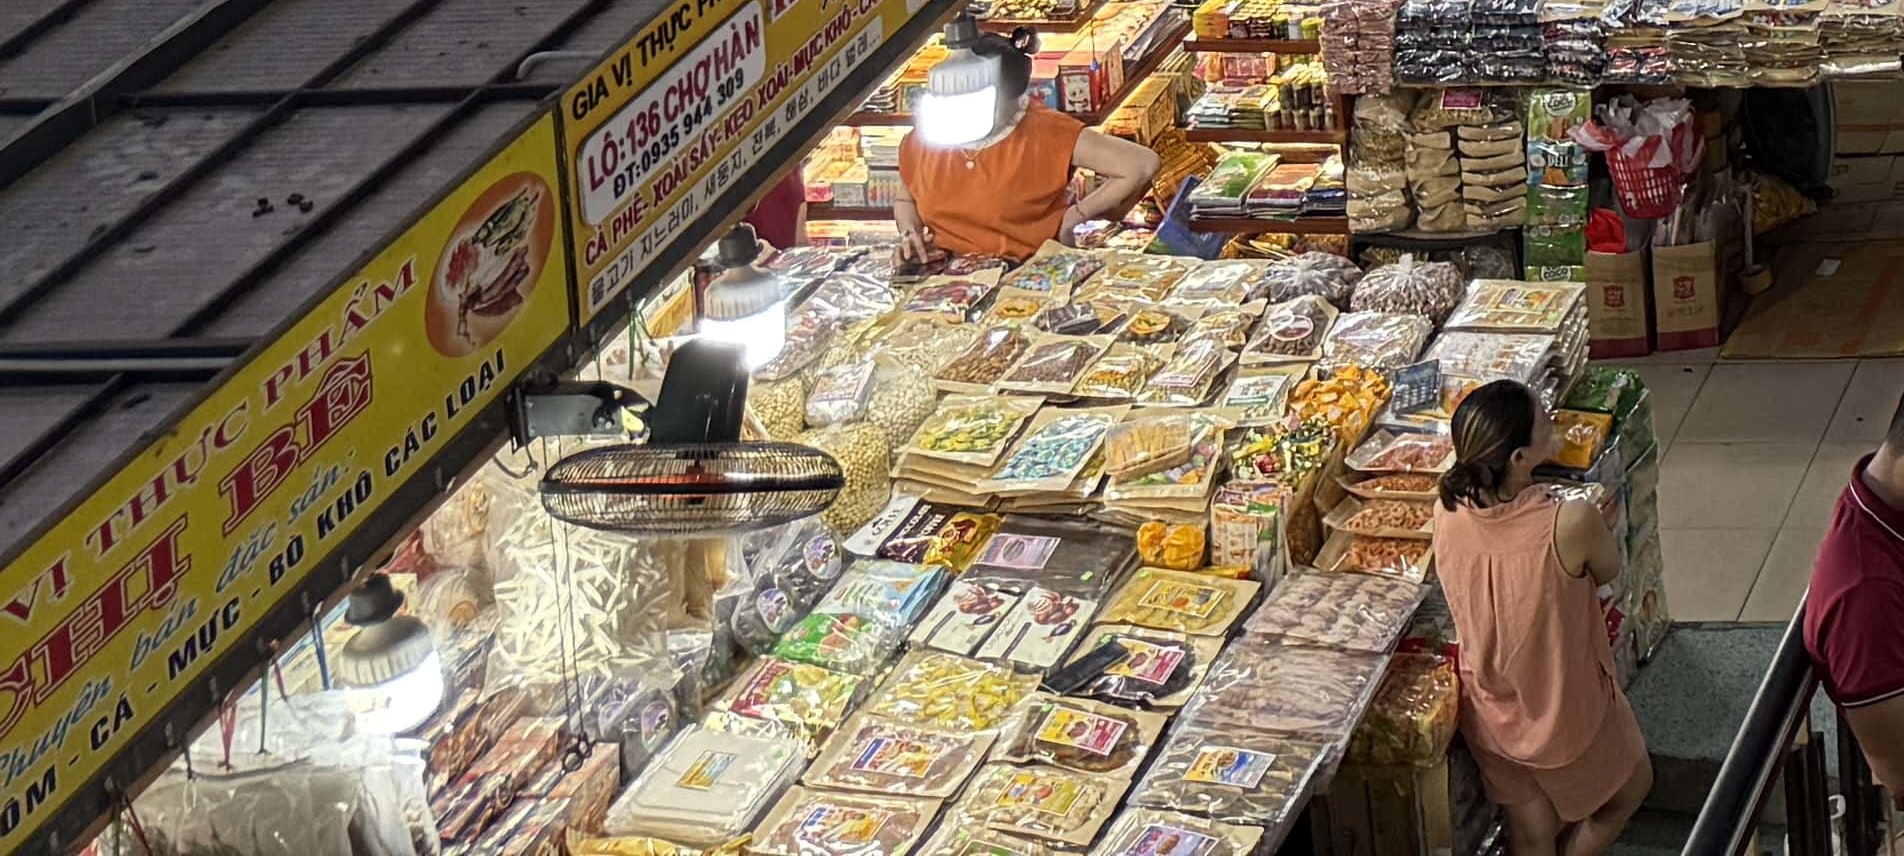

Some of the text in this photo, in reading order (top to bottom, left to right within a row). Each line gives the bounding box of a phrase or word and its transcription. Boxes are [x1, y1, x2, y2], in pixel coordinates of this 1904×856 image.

[572, 5, 693, 120] GIA VỊ THỰC
[663, 57, 710, 123] CHỢ
[712, 14, 761, 75] HÀN
[683, 102, 713, 135] 944
[717, 68, 745, 106] 309
[2, 258, 418, 622] VỊ THỰC PHẨM
[0, 348, 505, 837] ÔM CÁ MỰC BÒ KHÔ CÁC LOẠI
